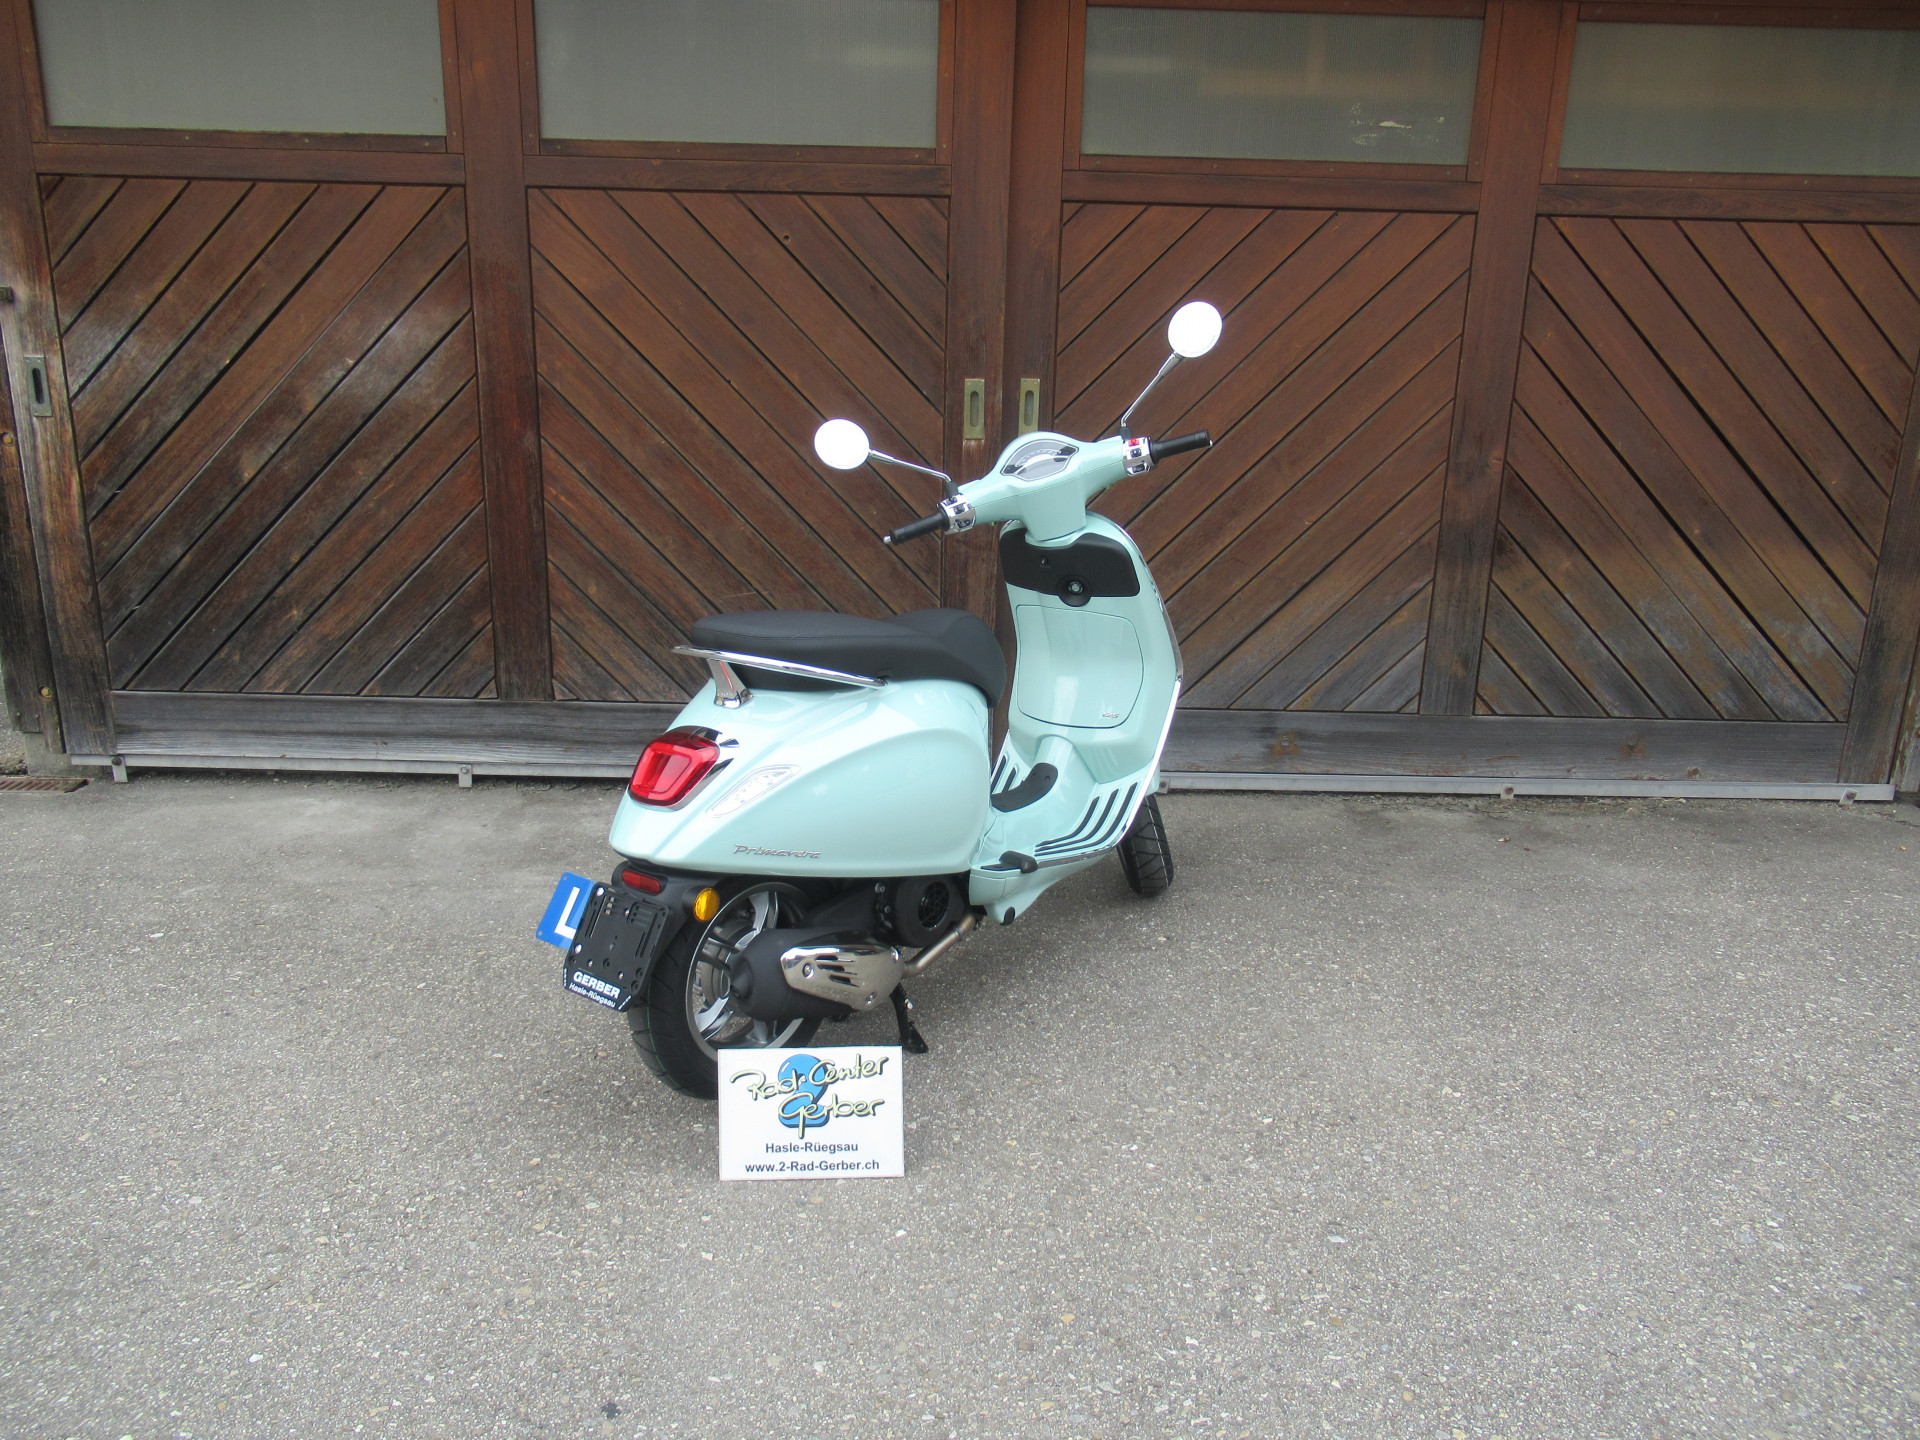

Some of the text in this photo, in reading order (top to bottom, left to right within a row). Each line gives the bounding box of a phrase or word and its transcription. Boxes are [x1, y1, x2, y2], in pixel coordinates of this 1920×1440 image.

[733, 843, 821, 858] Primavera
[554, 886, 580, 940] L
[573, 971, 621, 999] GERBER
[778, 1092, 885, 1139] Gerber
[765, 1141, 859, 1154] Hasle-Rüegsau
[745, 1159, 880, 1173] www.2-Rad-Gerber.ch
